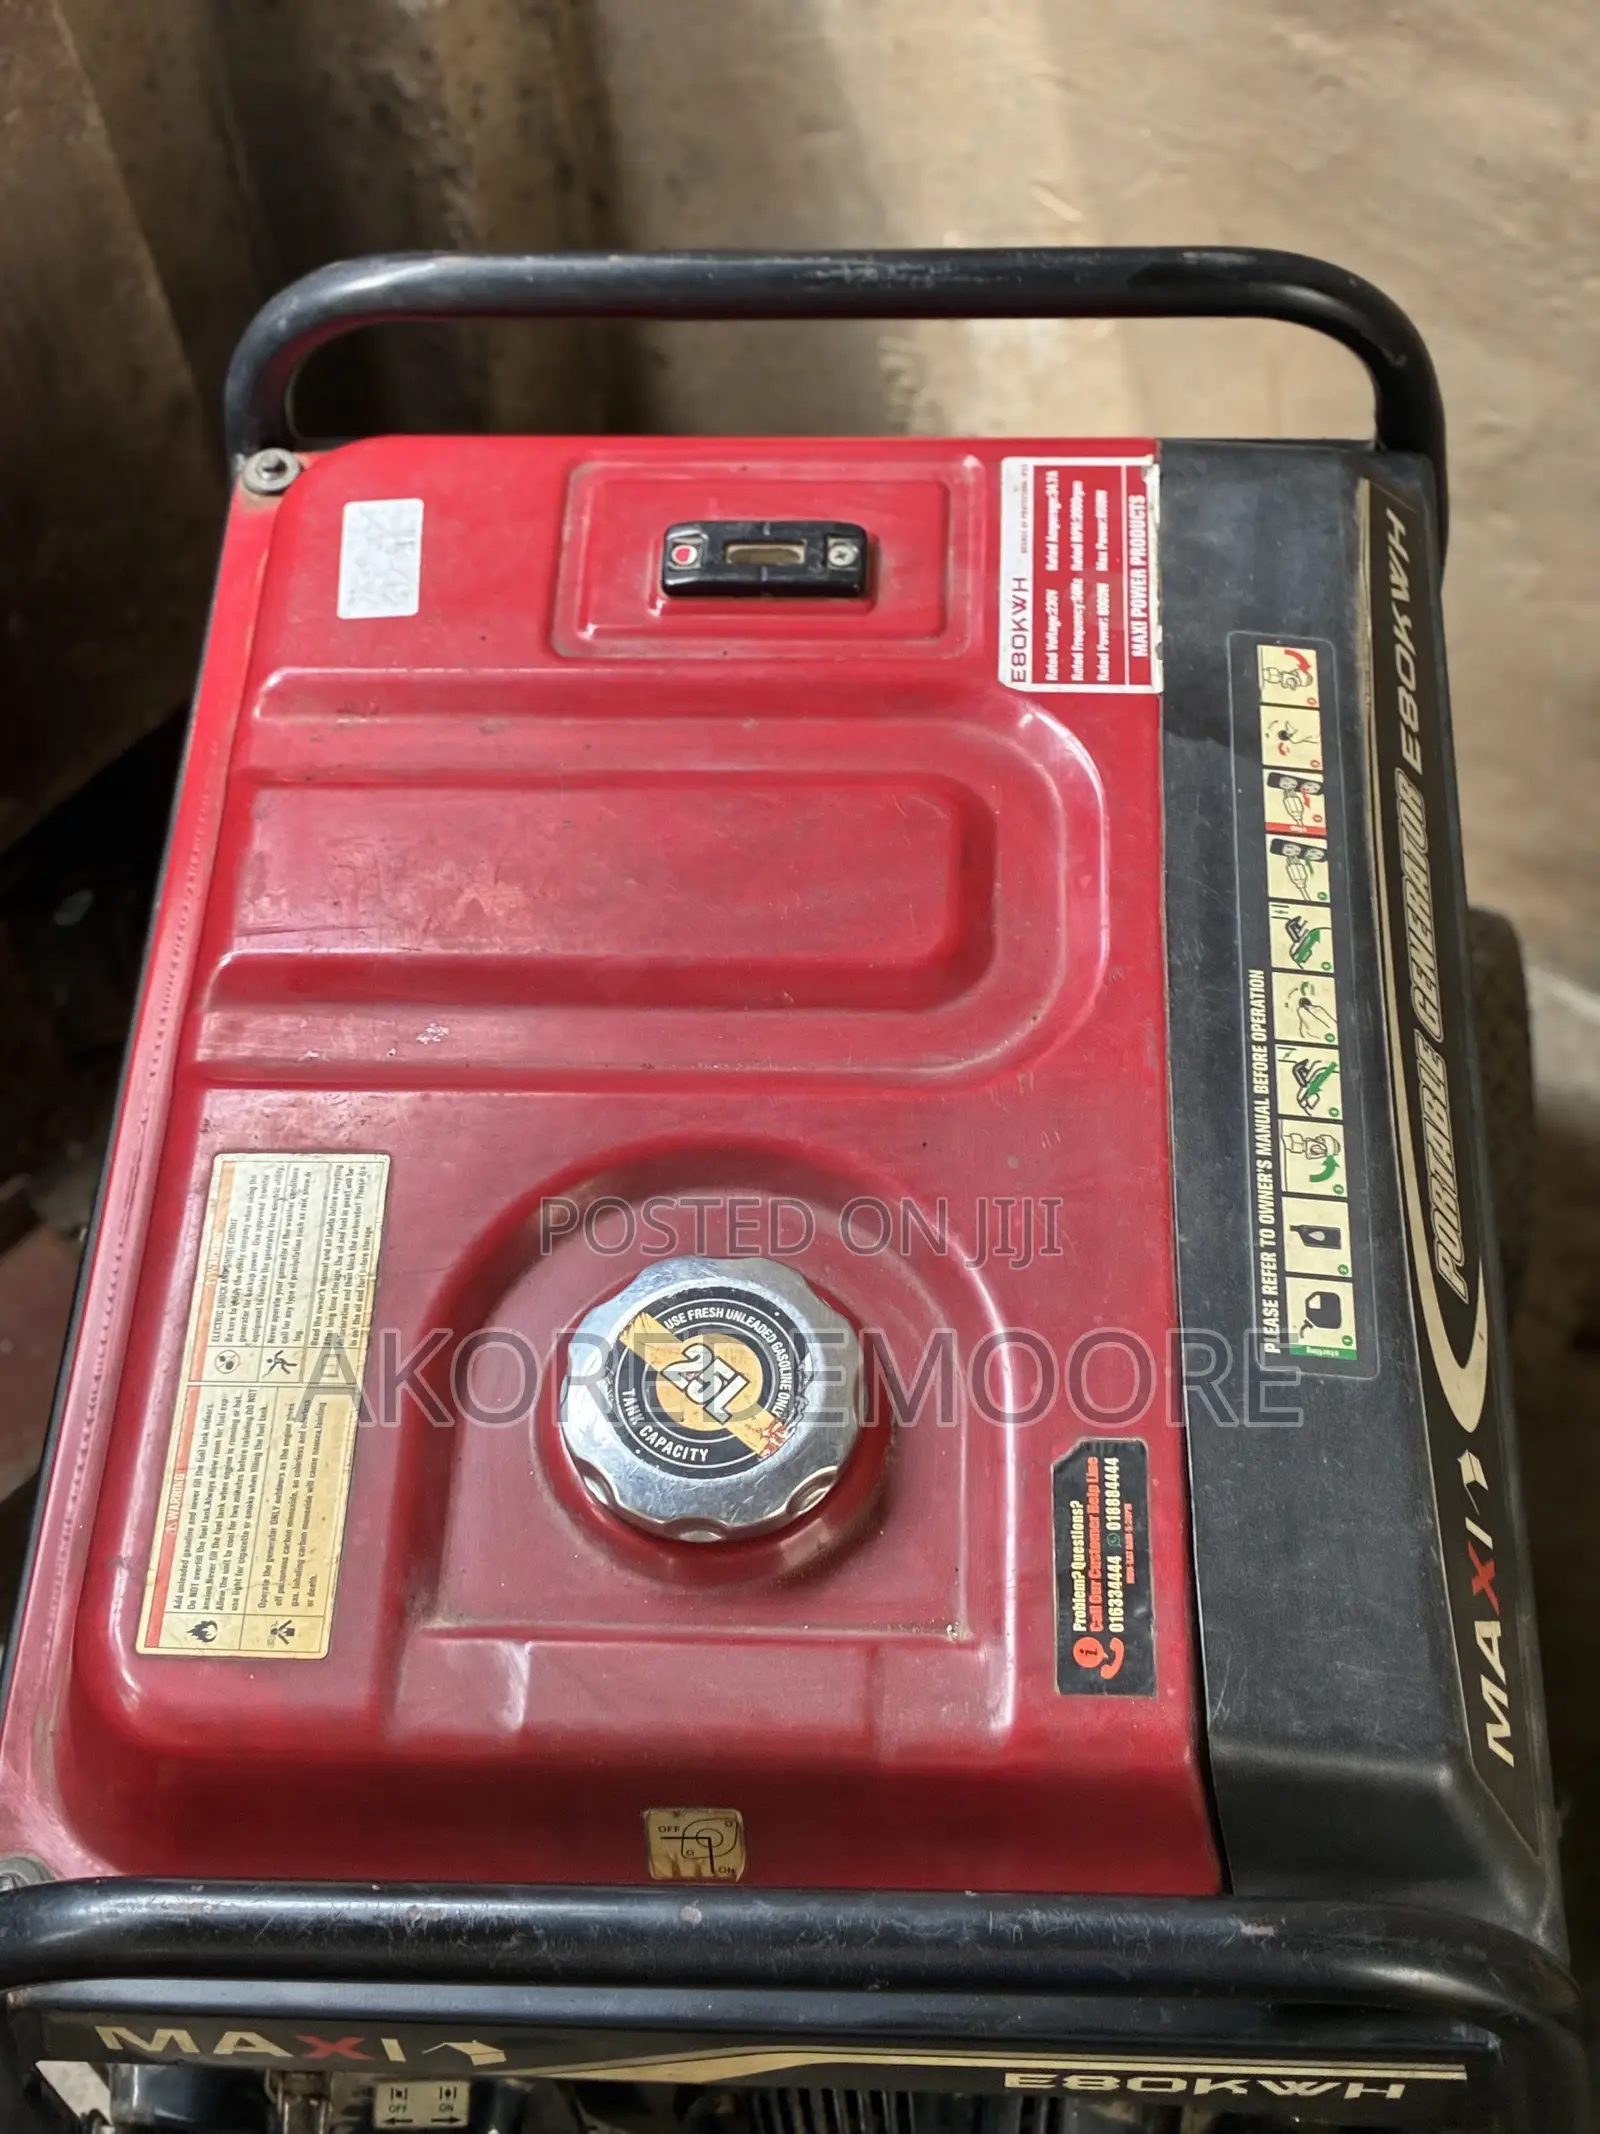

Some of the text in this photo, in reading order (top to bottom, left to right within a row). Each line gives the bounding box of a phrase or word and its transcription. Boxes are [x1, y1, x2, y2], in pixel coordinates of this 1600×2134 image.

[1045, 543, 1061, 570] Rated
[1070, 543, 1085, 570] Rated
[1129, 494, 1147, 656] MAXI POWER PRODUCTS
[1011, 577, 1029, 682] E80KWH
[1045, 652, 1061, 680] Rated
[1070, 652, 1085, 680] Rated
[1096, 652, 1109, 680] Rated
[1386, 507, 1469, 1304] PORTABLE GENERATOR E80KWH
[1248, 969, 1280, 1352] PLEASE REFER TO OWNER'S MANUAL BEFORE OPERATION
[211, 1310, 223, 1342] ELECTRIC
[312, 1315, 321, 1326] the
[266, 1324, 277, 1343] Never
[279, 1331, 289, 1343] call
[664, 1307, 792, 1419] USE FRESH UNLEADED GASOLINE ONLY
[660, 1342, 750, 1426] 25L
[246, 1388, 257, 1402] NOT
[216, 1412, 225, 1426] fuel
[622, 1388, 709, 1462] TANK CAPACITY
[197, 1431, 208, 1447] tank
[214, 1428, 223, 1437] for
[226, 1419, 240, 1445] running
[254, 1423, 265, 1436] fuel
[211, 1439, 221, 1457] room
[252, 1438, 263, 1450] the
[192, 1464, 203, 1476] the
[207, 1460, 218, 1478] allow
[236, 1450, 247, 1472] before
[307, 1457, 317, 1478] cause
[218, 1481, 228, 1500] when
[246, 1474, 257, 1493] when
[305, 1480, 314, 1493] will
[166, 1472, 185, 1520] WARNING
[187, 1490, 199, 1509] never
[185, 1511, 196, 1524] and
[215, 1503, 225, 1518] tank
[229, 1504, 239, 1517] two
[257, 1423, 293, 1608] Operate the generator ONLY as the engine
[272, 1596, 282, 1606] off
[280, 1528, 292, 1554] carbon
[289, 1479, 298, 1488] an
[295, 1431, 305, 1443] and
[198, 1524, 208, 1538] fuel
[213, 1520, 222, 1534] fuel
[227, 1520, 236, 1530] for
[180, 1527, 195, 1557] gasoline
[196, 1540, 205, 1552] the
[210, 1537, 220, 1548] the
[224, 1532, 235, 1547] cool
[236, 1530, 251, 1564] cigarette
[296, 1531, 308, 1556] carbon
[1085, 1456, 1103, 1632] Call Our Customer Help Line
[1103, 1456, 1124, 1632] 016334444 018884444
[209, 1550, 218, 1560] fill
[223, 1549, 232, 1557] to
[220, 1559, 230, 1574] unit
[234, 1565, 244, 1576] for
[1069, 1499, 1087, 1632] Problem? Questions?
[174, 1559, 189, 1593] unleaded
[218, 1576, 228, 1588] the
[188, 1582, 198, 1597] NOT
[231, 1578, 244, 1595] light
[172, 1595, 183, 1609] Add
[186, 1599, 196, 1609] Do
[1464, 1516, 1515, 1768] MAXI
[657, 1825, 681, 1833] OFF
[95, 2026, 405, 2062] MAXI
[1003, 2072, 1406, 2100] E80KWH
[388, 2104, 454, 2113] OFF ON
